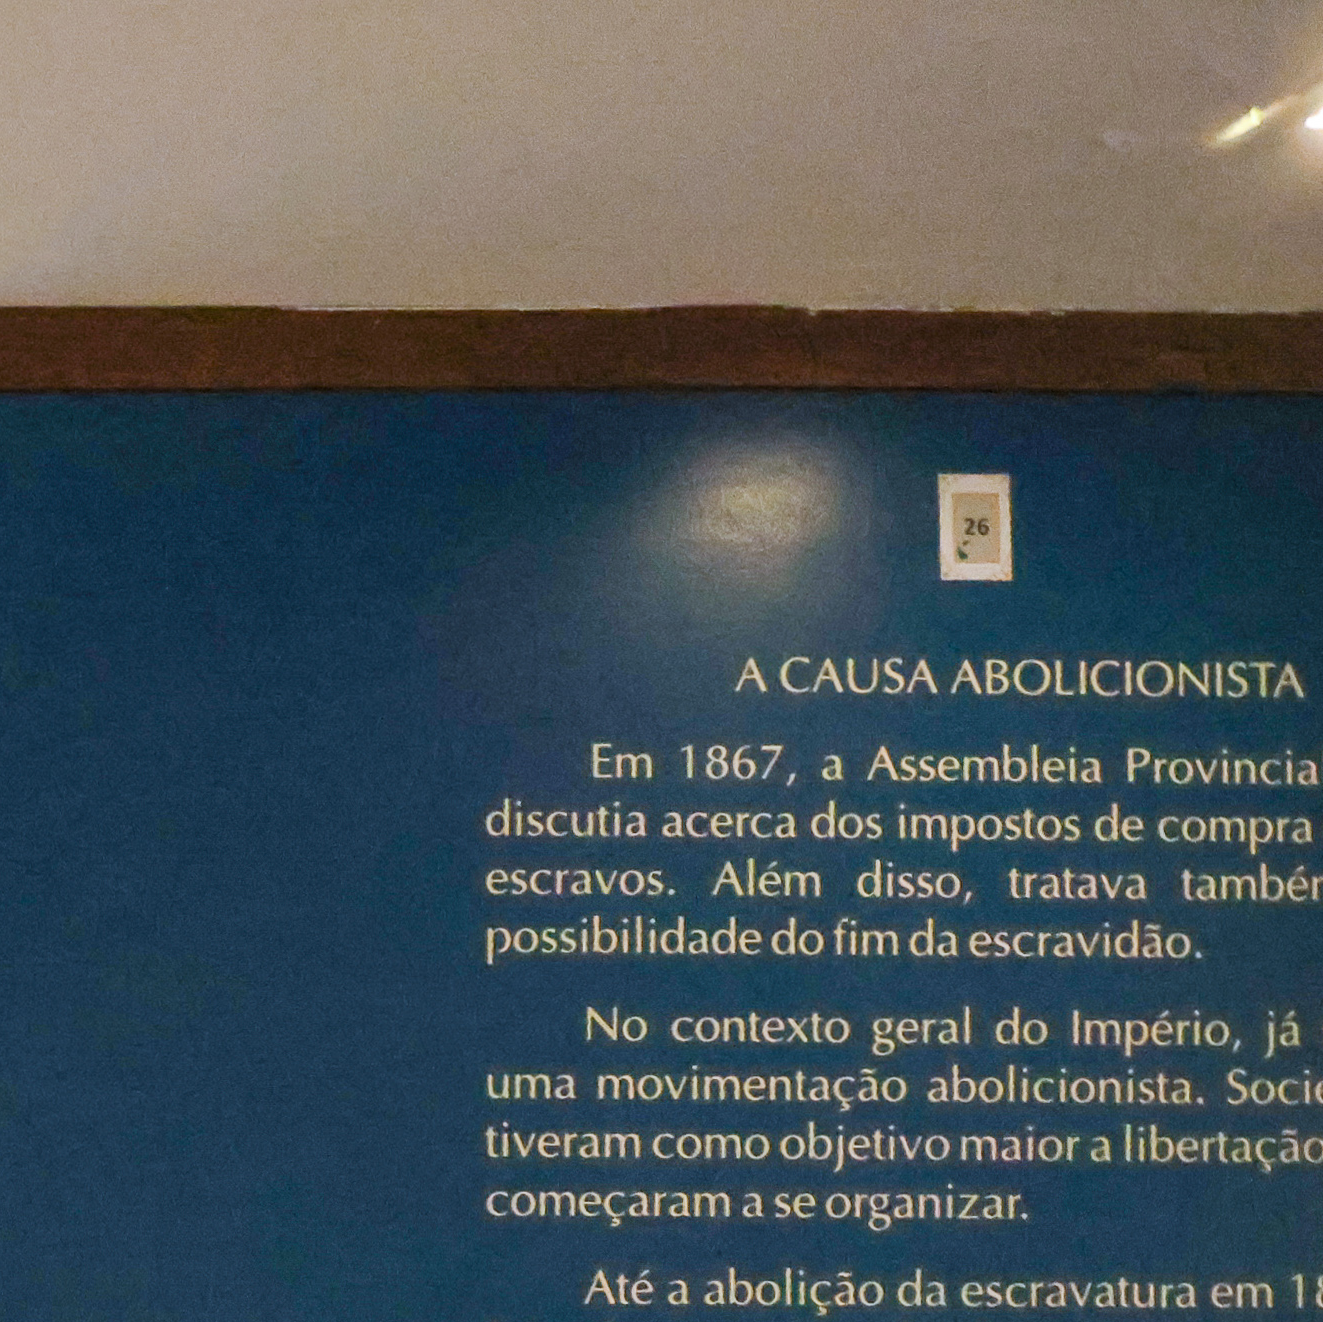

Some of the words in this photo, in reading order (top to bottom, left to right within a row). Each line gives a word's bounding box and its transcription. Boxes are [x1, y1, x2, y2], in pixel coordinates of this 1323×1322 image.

[963, 517, 991, 536] 26
[734, 657, 768, 693] A
[779, 656, 939, 695] CAUSA
[950, 657, 1306, 699] ABOLICIONISTA
[591, 742, 654, 779] Em
[681, 744, 796, 786] 1867,
[821, 754, 844, 781] a
[867, 743, 1103, 784] Assembleia
[484, 797, 647, 838] discutia
[661, 811, 798, 839] acerca
[809, 799, 883, 840] dos
[897, 803, 1082, 853] impostos
[1093, 802, 1145, 842] de
[1157, 815, 1313, 855] compra
[484, 868, 676, 896] escravos.
[711, 858, 822, 897] Além
[856, 859, 973, 904] disso,
[1008, 868, 1147, 901] tratava
[485, 915, 763, 966] possibilidade
[770, 917, 826, 957] do
[833, 917, 900, 957] fim
[908, 918, 959, 958] da
[967, 919, 1203, 960] escravidão.
[585, 1006, 649, 1043] No
[669, 1011, 852, 1044] contexto
[871, 1005, 972, 1056] geral
[994, 1005, 1049, 1046] do
[1071, 1009, 1241, 1057] Império,
[1265, 1010, 1301, 1058] já
[486, 1073, 577, 1100] uma
[597, 1065, 908, 1111] movimentação
[927, 1064, 1205, 1105] abolicionista.
[484, 1121, 642, 1159] tiveram
[651, 1132, 771, 1160] como
[779, 1121, 952, 1172] objetivo
[960, 1126, 1080, 1163] maior
[1089, 1136, 1112, 1163] a
[1124, 1124, 1323, 1174] libertação
[485, 1190, 732, 1228] começaram
[741, 1192, 765, 1219] a
[773, 1192, 817, 1220] se
[824, 1184, 1029, 1232] organizar.
[583, 1268, 655, 1306] Até
[667, 1279, 690, 1306] a
[703, 1266, 885, 1316] abolição
[896, 1268, 947, 1307] da
[960, 1276, 1197, 1309] escravatura
[1210, 1282, 1274, 1309] em
